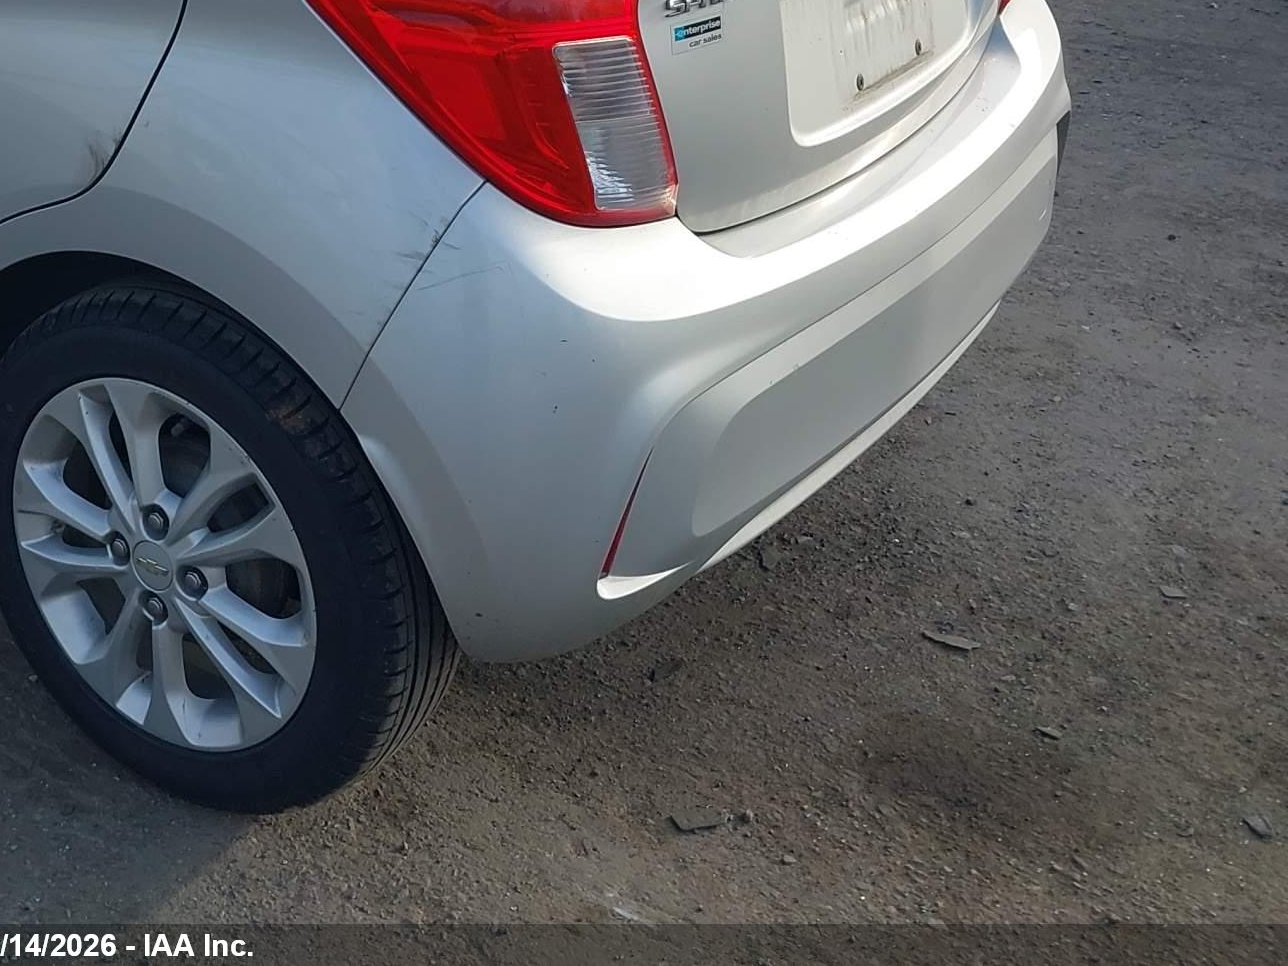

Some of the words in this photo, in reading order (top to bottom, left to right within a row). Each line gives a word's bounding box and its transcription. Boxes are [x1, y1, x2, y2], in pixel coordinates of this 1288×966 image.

[675, 19, 721, 39] enterprise
[689, 38, 701, 48] car
[703, 32, 722, 44] sales
